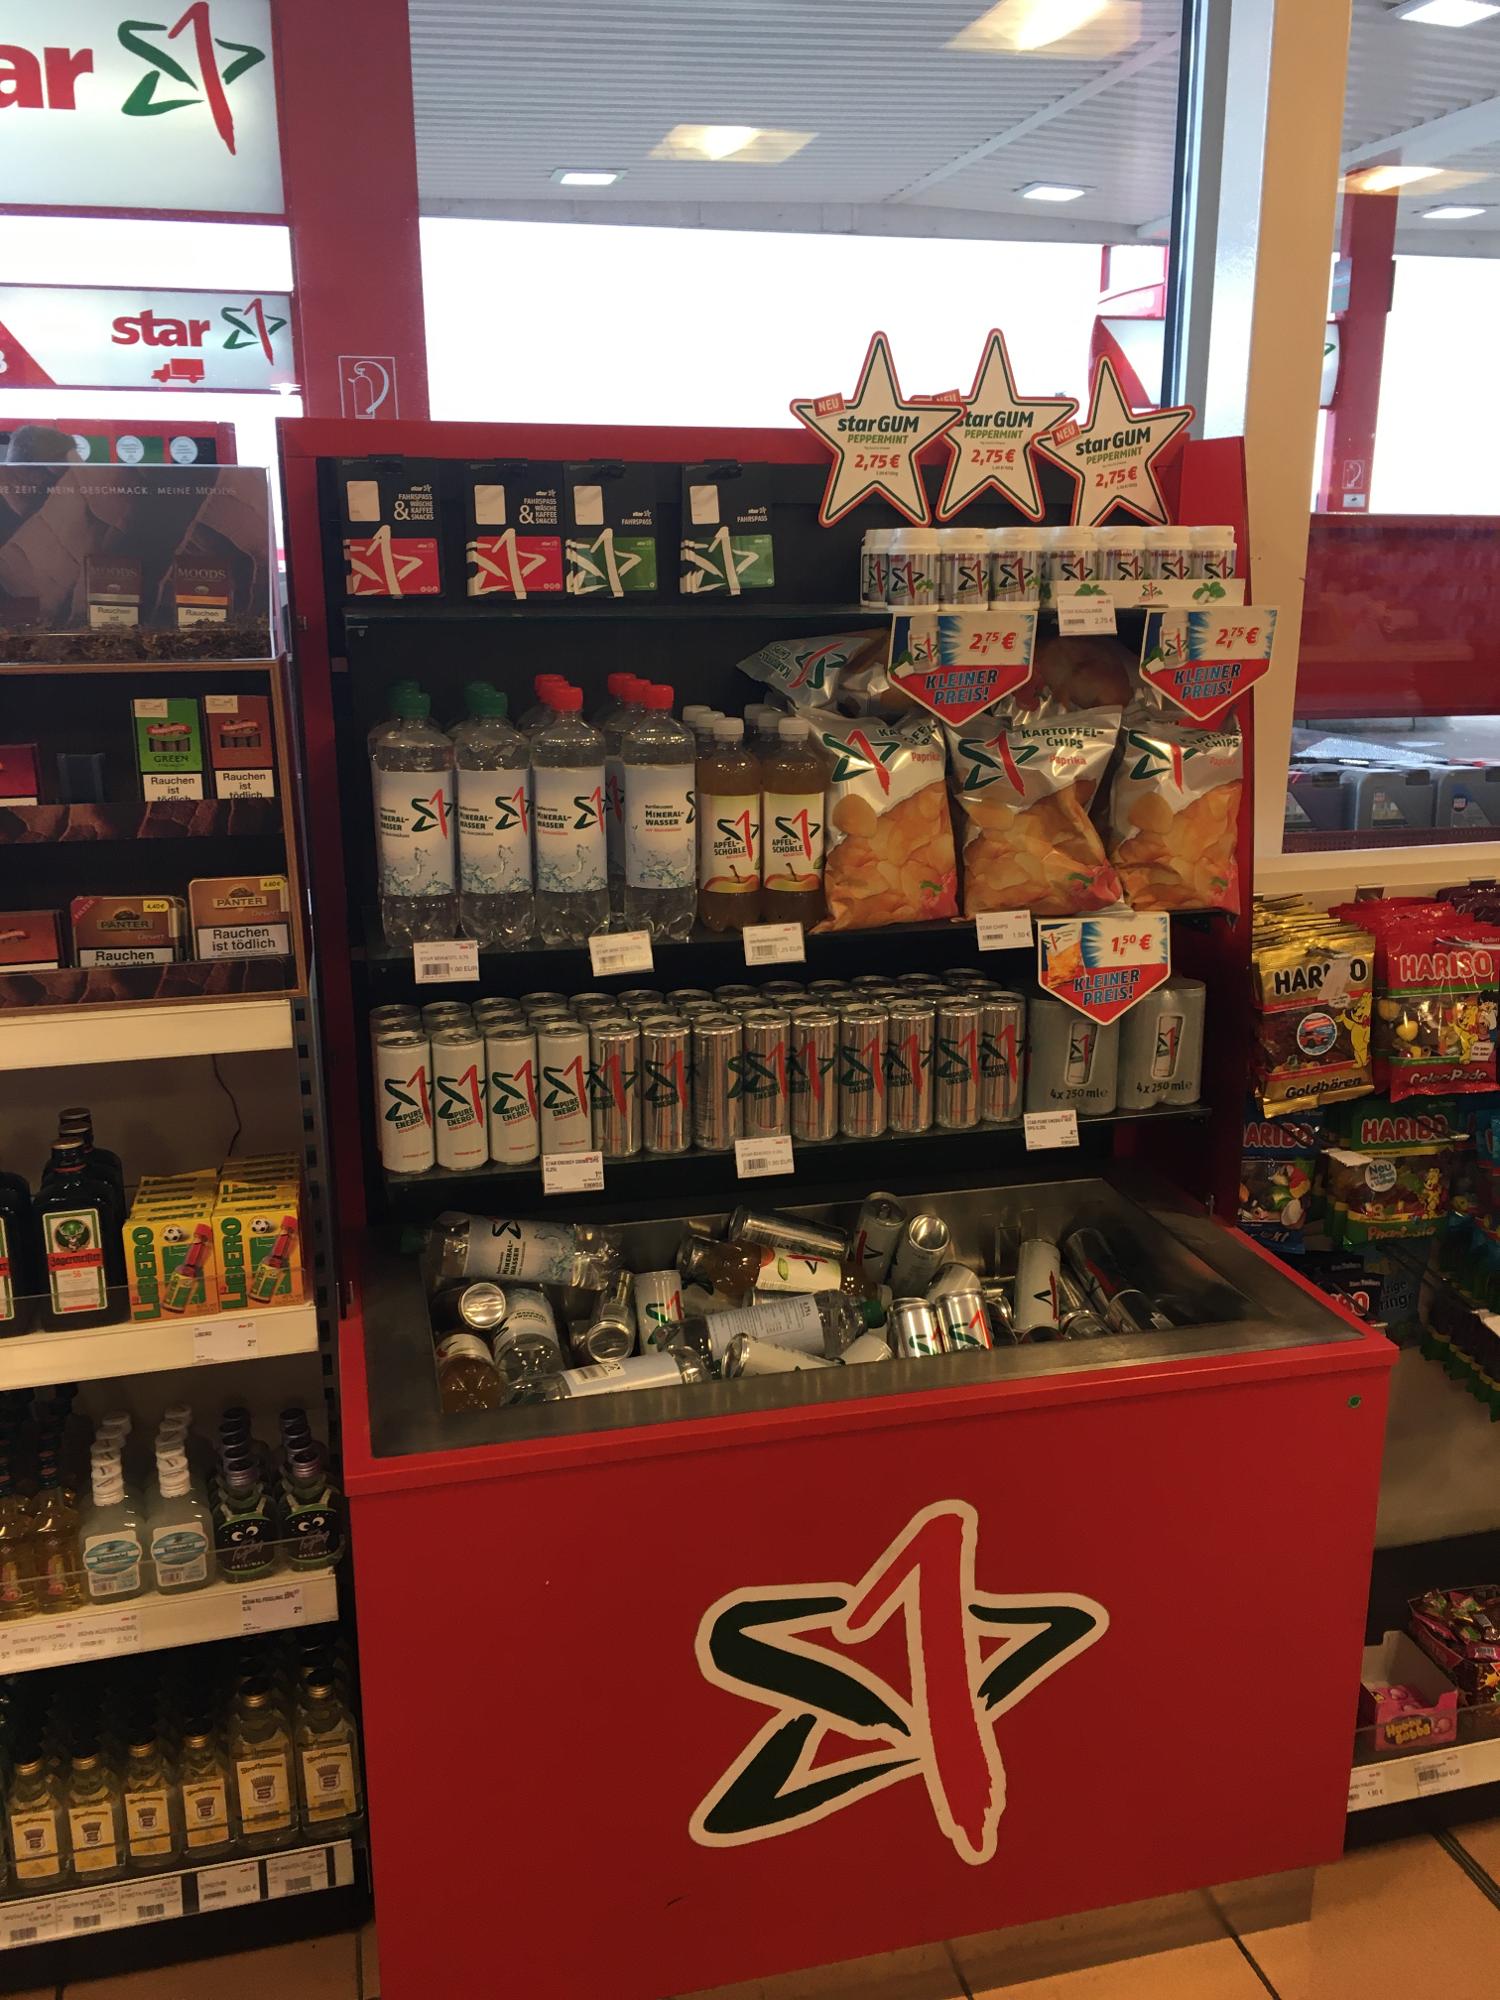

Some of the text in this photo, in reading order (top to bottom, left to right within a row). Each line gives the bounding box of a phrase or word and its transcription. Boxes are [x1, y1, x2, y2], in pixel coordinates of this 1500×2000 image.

[111, 309, 210, 347] star
[818, 400, 839, 412] NEU
[847, 434, 909, 444] PEPPERMINT
[965, 430, 1023, 439] PEPPERMINT
[1056, 425, 1076, 442] NEU
[1086, 447, 1143, 465] PEPPERMINT
[47, 486, 75, 495] MEIN
[157, 486, 191, 495] MEINE
[394, 501, 410, 520] &
[519, 505, 534, 524] &
[737, 515, 768, 523] FAHRSPASS
[178, 568, 227, 579] MOODS
[186, 609, 219, 617] Rauchen
[925, 669, 999, 690] KLEINER
[1175, 664, 1241, 684] KLEINER
[934, 687, 989, 705] PREIS!
[1182, 681, 1232, 699] PREIS!
[1021, 727, 1104, 739] KARTOFFEL-
[1046, 737, 1083, 749] CHIPS
[1205, 738, 1239, 748] CHIPS
[153, 755, 189, 763] GREEN
[1049, 754, 1088, 766] Paprika
[151, 777, 195, 785] Rauchen
[223, 773, 266, 781] Rauchen
[240, 782, 252, 790] ist
[229, 791, 263, 799] tödlich
[772, 838, 797, 846] APFEL-
[714, 847, 746, 856] SCHORLE
[772, 845, 803, 853] SCHORLE
[216, 898, 264, 906] PANTER
[101, 920, 149, 928] PANTER
[213, 928, 269, 939] Rauchen
[212, 938, 276, 951] ist tödlich
[1139, 934, 1152, 950] €
[95, 951, 154, 960] Rauchen
[1074, 969, 1140, 992] KLEINER
[1274, 957, 1368, 996] HARO
[1083, 985, 1134, 1006] PREIS!
[1151, 1082, 1170, 1093] 250
[1171, 1080, 1184, 1090] ml
[1285, 1077, 1362, 1098] Goldbären
[1066, 1089, 1084, 1099] 250
[1086, 1088, 1099, 1098] ml
[509, 1102, 528, 1114] PURE
[559, 1098, 579, 1108] PURE
[402, 1108, 422, 1120] PURE
[453, 1106, 473, 1119] PURE
[502, 1109, 530, 1122] ENERGY
[553, 1103, 580, 1117] ENERGY
[396, 1116, 424, 1129] ENERGY
[447, 1114, 476, 1127] ENERGY
[1244, 1122, 1315, 1148] ARIBO
[1362, 1115, 1448, 1144] HARIBO
[1369, 1163, 1393, 1174] Neu
